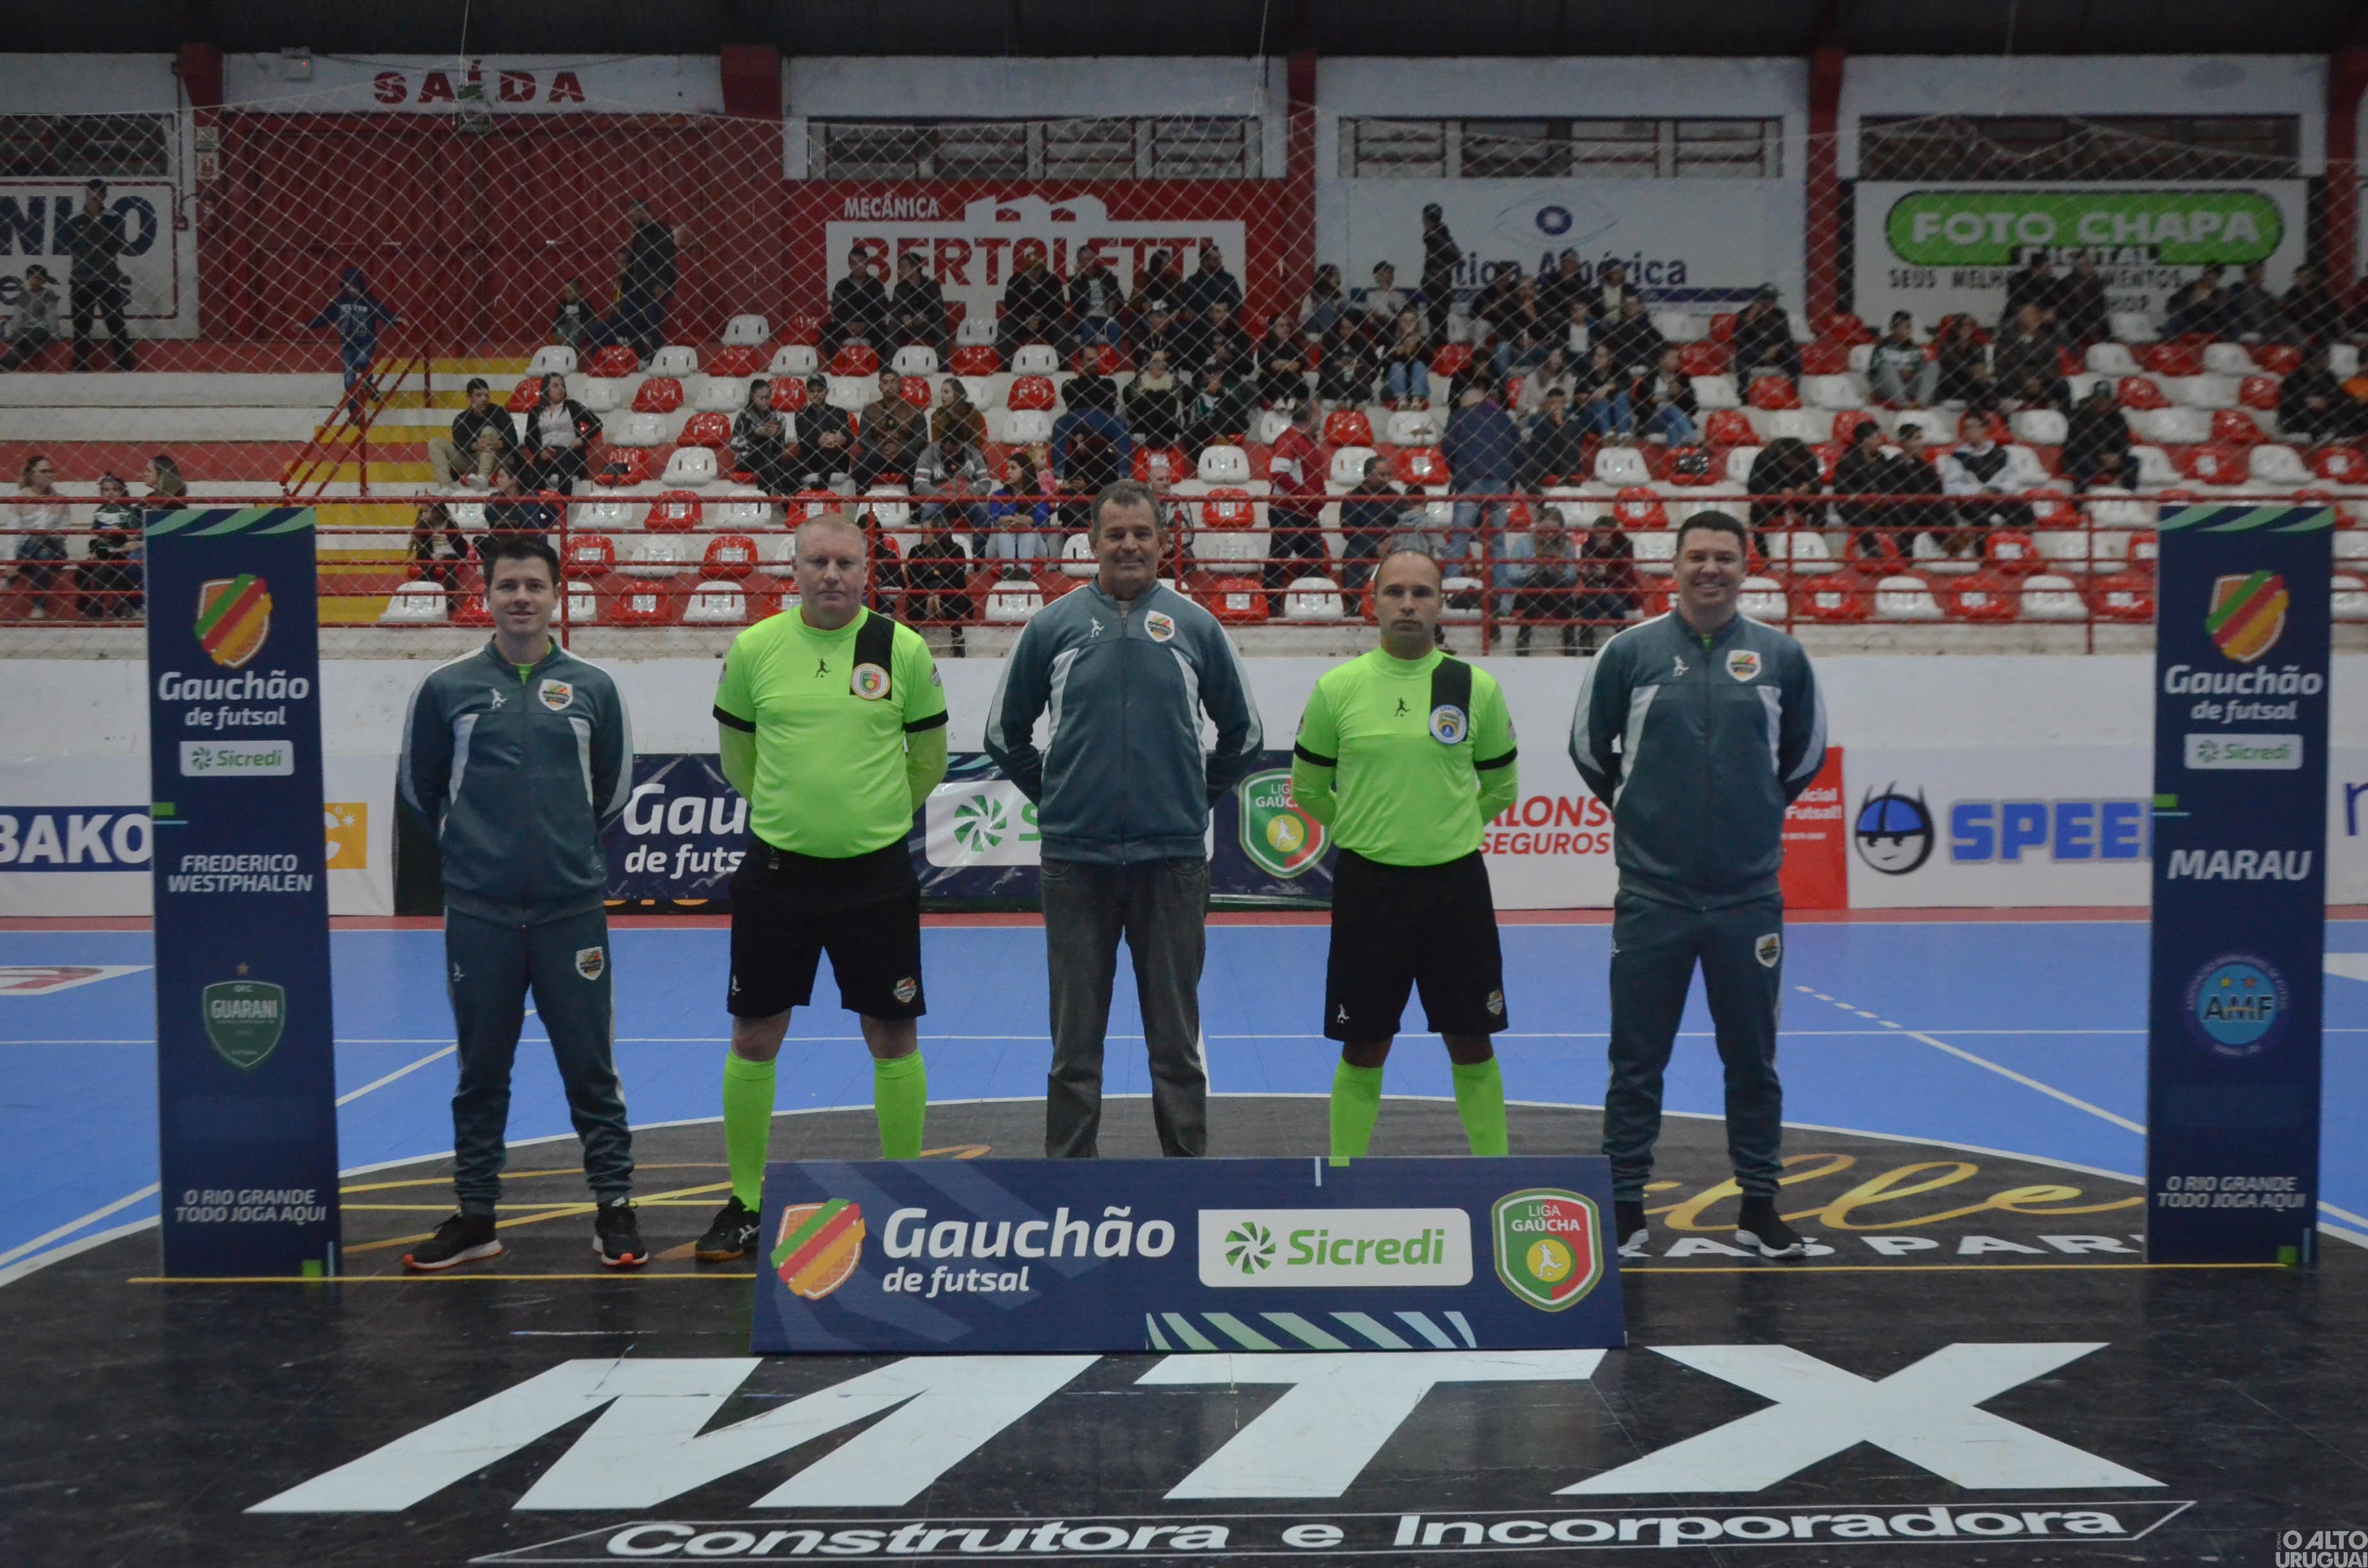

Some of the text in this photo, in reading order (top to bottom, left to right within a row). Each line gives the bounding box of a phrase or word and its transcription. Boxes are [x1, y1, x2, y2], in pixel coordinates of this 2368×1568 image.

[844, 196, 939, 219] MECÂNICA
[1912, 211, 2260, 245] FOTO CHAPA
[851, 237, 1215, 286] BERTOLETT
[158, 669, 309, 701] Gauchão
[2164, 664, 2323, 695] Gauchão
[185, 706, 286, 730] de futsal
[2191, 700, 2298, 724] de futsal
[217, 749, 282, 767] Sicredi
[2224, 743, 2291, 760] Sicredi
[1270, 783, 1292, 794] LIG
[1254, 794, 1299, 808] GAÚC
[1493, 796, 1615, 827] LONS
[1479, 832, 1611, 854] SEGUROS
[1950, 802, 2151, 862] SPEE
[181, 854, 298, 872] FREDERICO
[625, 844, 746, 879] de futs
[2167, 849, 2312, 881] MARAU
[168, 874, 313, 892] WESTPHALEN
[211, 999, 277, 1018] GUARANI
[2200, 993, 2273, 1023] AMF
[2167, 1176, 2298, 1191] O RIO GRANDE
[185, 1189, 316, 1205] O RIO GRANDE
[2157, 1193, 2306, 1212] TODO JOGA AQUI
[176, 1206, 326, 1225] TODO JOGA AQUI
[1528, 1204, 1561, 1217] LIGA
[882, 1205, 1175, 1259] Gauchão
[1511, 1216, 1581, 1232] GAÚCHA
[1287, 1229, 1445, 1266] Sicredi
[882, 1265, 1030, 1298] de futsal
[243, 1343, 2169, 1514] MTX
[605, 1507, 2127, 1558] Construtora e Incorporadora
